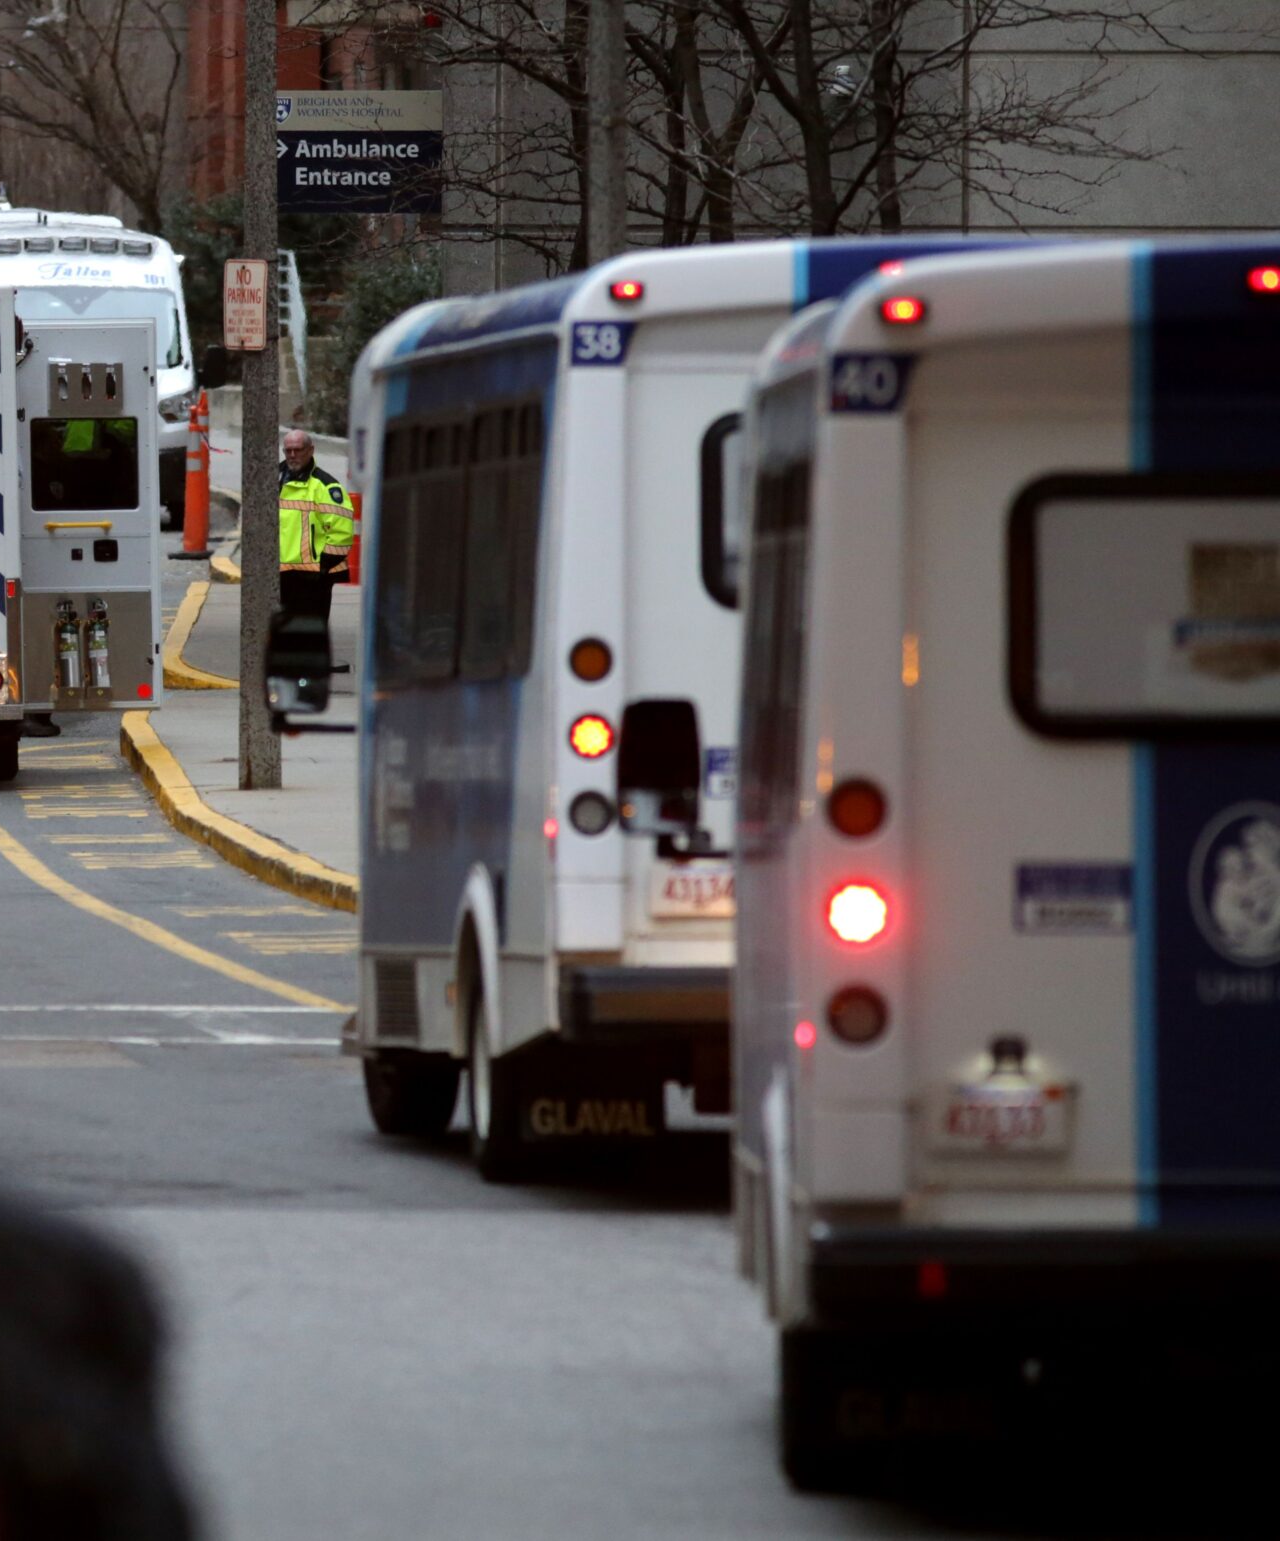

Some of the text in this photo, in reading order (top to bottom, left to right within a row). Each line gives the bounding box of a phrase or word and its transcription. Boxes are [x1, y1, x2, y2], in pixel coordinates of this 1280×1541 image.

[297, 97, 374, 106] BRIGHAM AND
[297, 108, 404, 117] WOMEN'S HOSPITAL
[295, 138, 419, 158] Ambulance
[295, 167, 391, 186] Entrance
[38, 262, 112, 280] Fallon
[236, 269, 252, 285] NO
[227, 288, 262, 304] PARKING
[575, 324, 620, 360] 38
[836, 357, 898, 406] 40
[530, 1098, 655, 1135] GLAVAL
